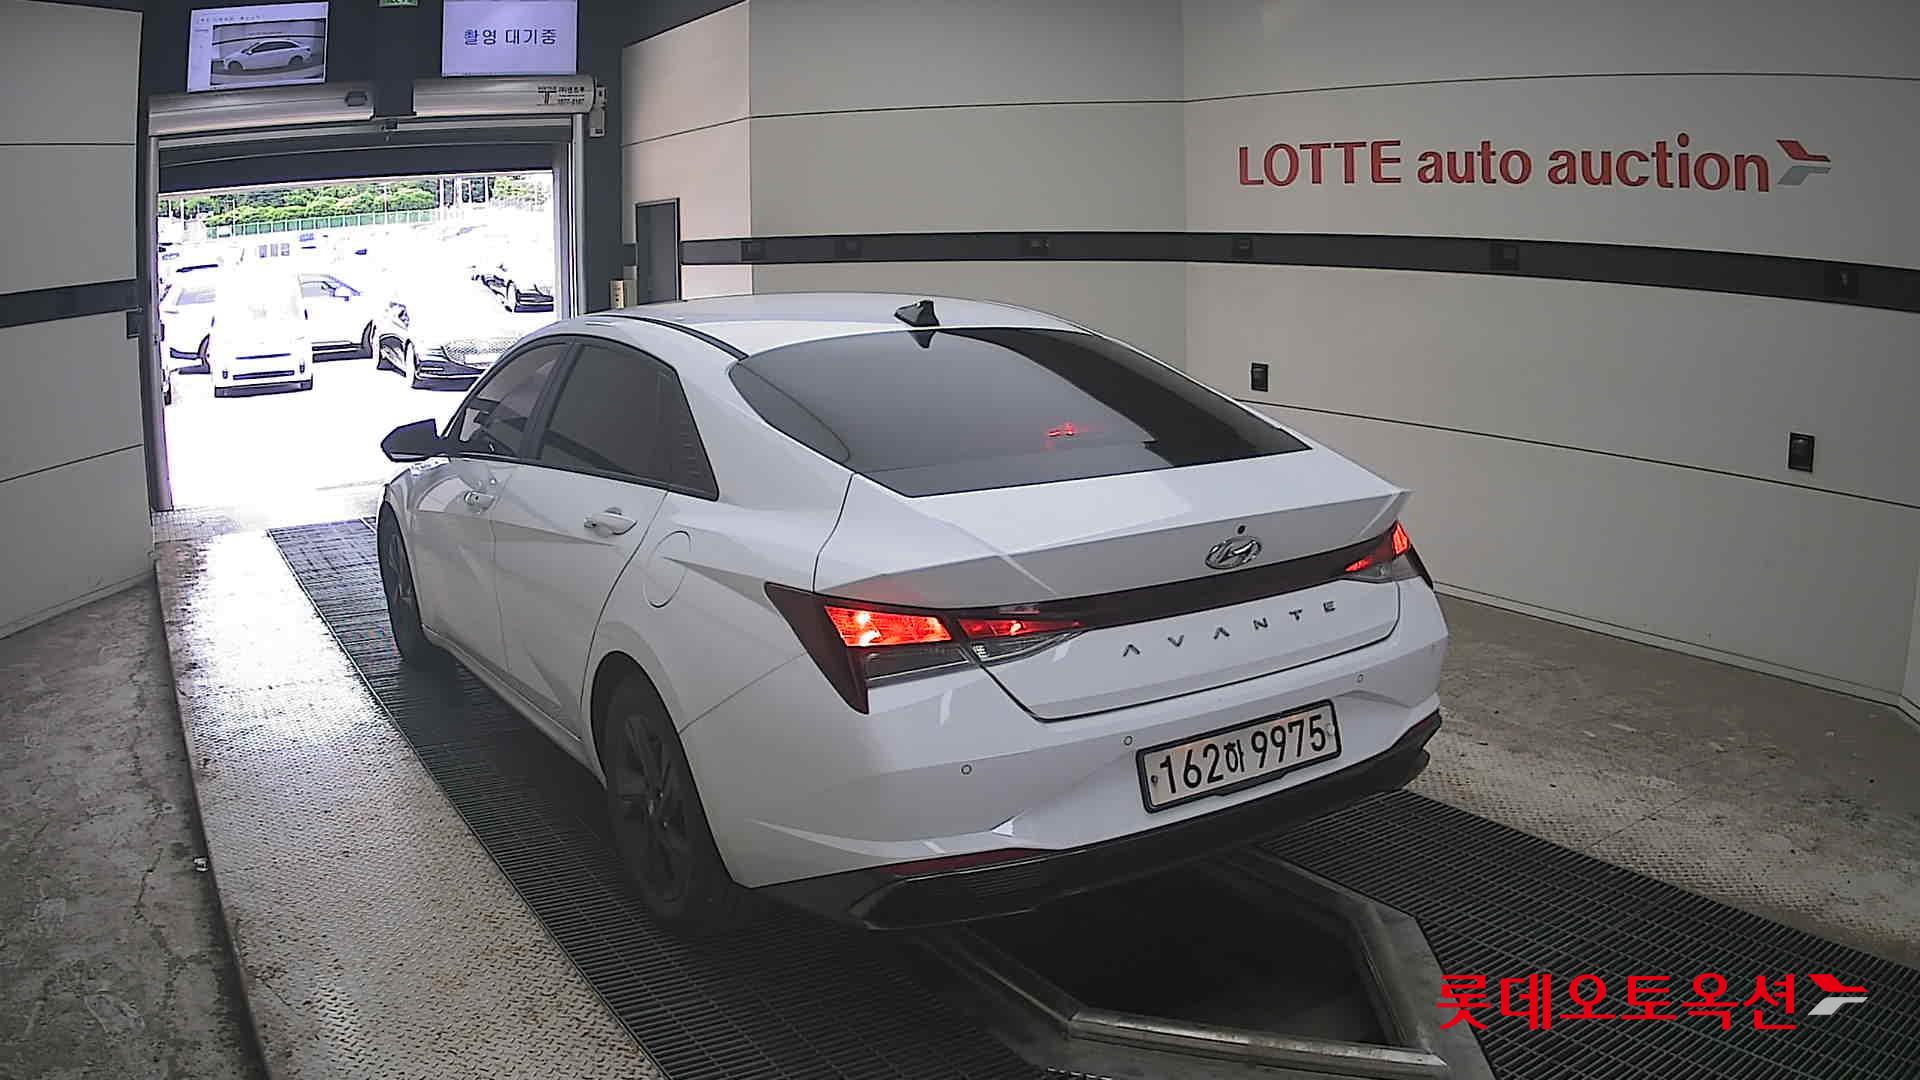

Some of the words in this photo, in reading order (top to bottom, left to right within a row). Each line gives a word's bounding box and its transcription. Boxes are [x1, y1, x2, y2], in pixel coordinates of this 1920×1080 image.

[504, 28, 558, 46] 대기중
[1238, 139, 1402, 187] LOTTE
[1416, 140, 1533, 186] auto
[1547, 132, 1771, 193] auction
[1122, 600, 1336, 658] AVANTE
[1251, 714, 1327, 769] 9975
